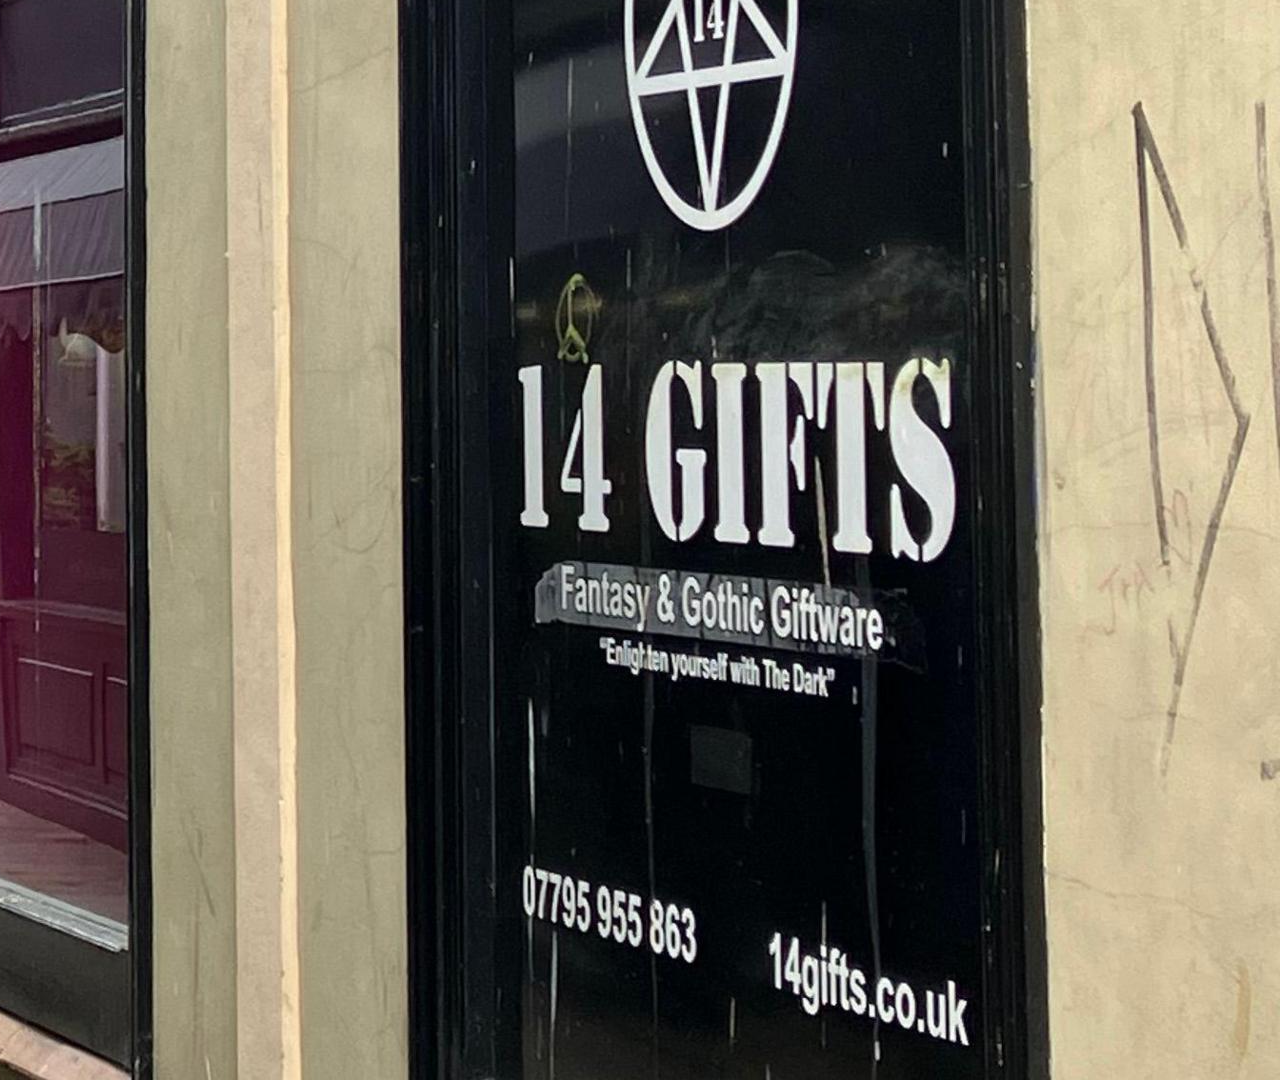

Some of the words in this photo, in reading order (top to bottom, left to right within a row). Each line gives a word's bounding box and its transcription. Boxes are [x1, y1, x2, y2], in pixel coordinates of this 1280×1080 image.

[518, 362, 612, 533] 14
[644, 356, 957, 563] GIFTS
[560, 565, 650, 632] Fantasy
[656, 573, 675, 624] &
[681, 576, 765, 635] Gothic
[770, 585, 884, 651] Giftware
[670, 652, 729, 681] yourself
[729, 655, 761, 687] with
[762, 658, 791, 691] The
[522, 865, 591, 933] 07795
[597, 883, 643, 948] 955
[649, 899, 697, 963] 863
[768, 932, 970, 1047] 14gifts.co.uk
